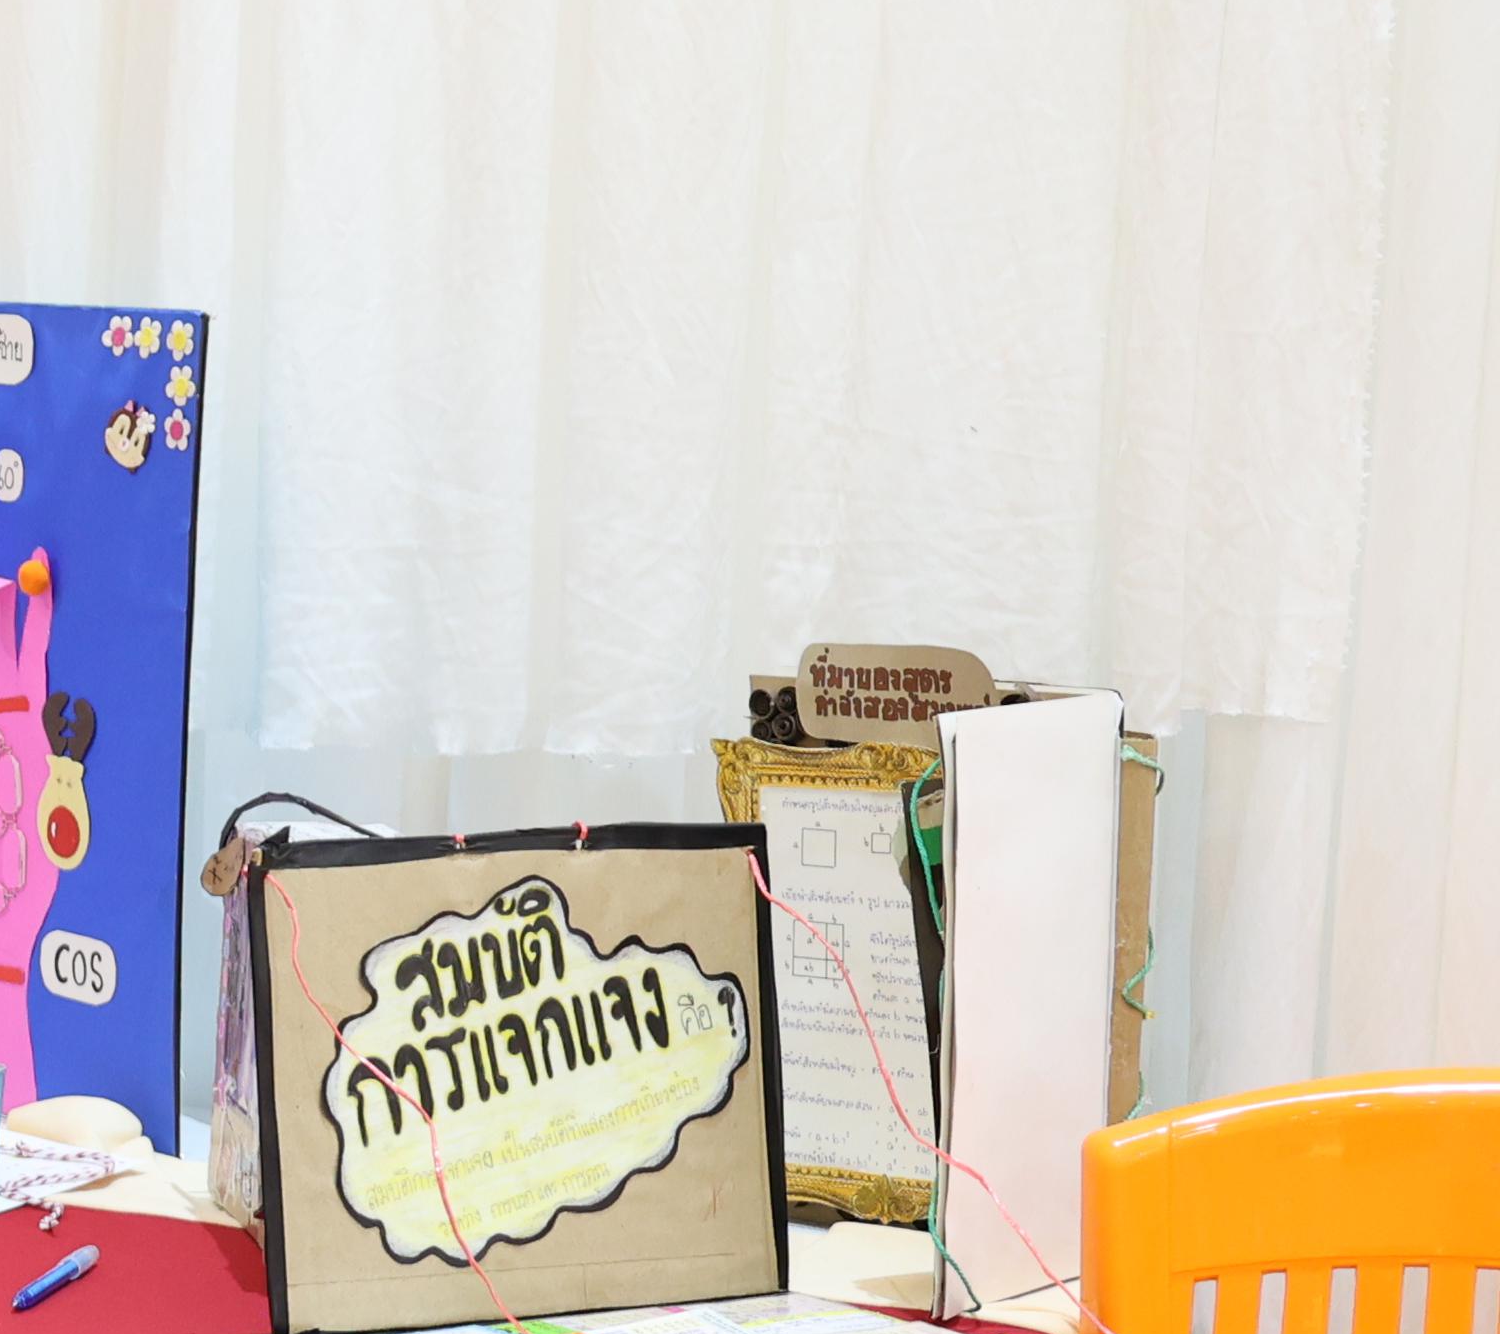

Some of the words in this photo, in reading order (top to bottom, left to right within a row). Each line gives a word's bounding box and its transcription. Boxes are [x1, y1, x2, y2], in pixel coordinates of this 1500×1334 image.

[395, 888, 564, 1032] สมบัติ
[347, 967, 670, 1148] การแจกแจง
